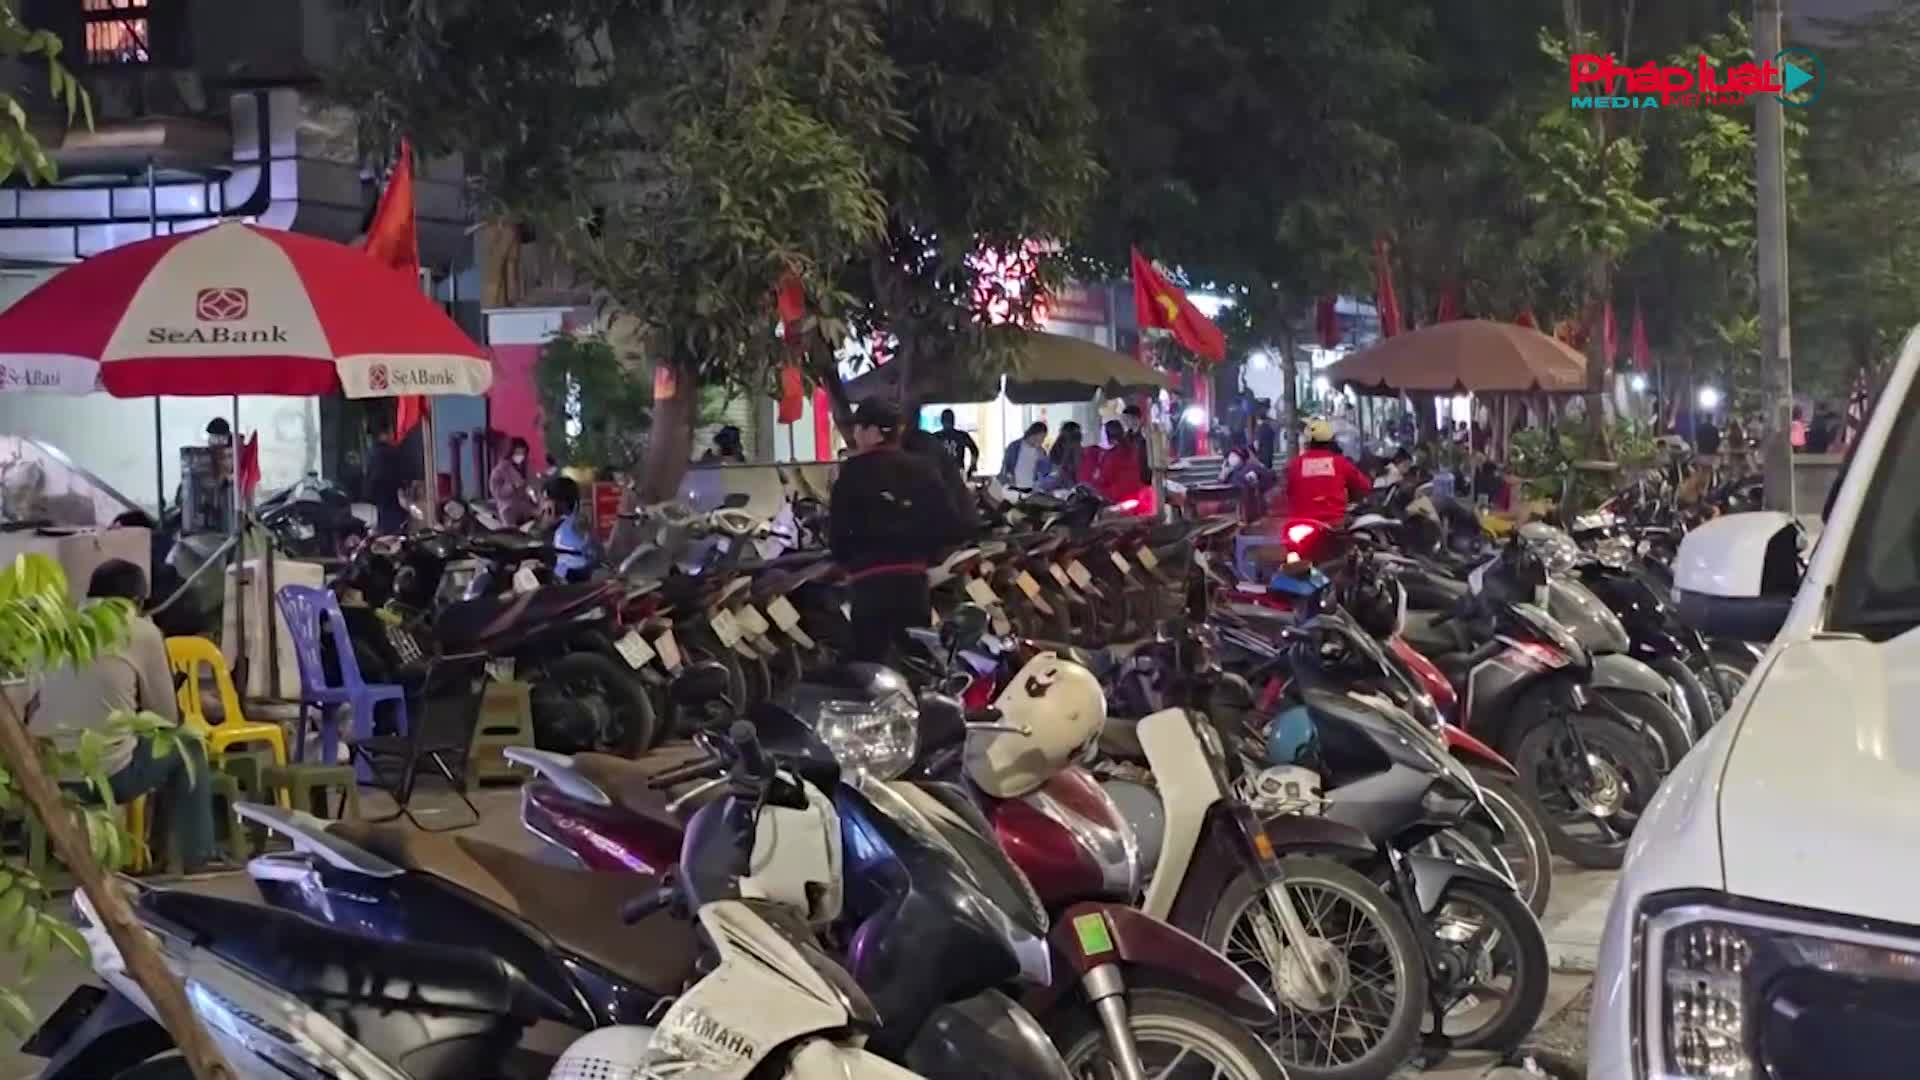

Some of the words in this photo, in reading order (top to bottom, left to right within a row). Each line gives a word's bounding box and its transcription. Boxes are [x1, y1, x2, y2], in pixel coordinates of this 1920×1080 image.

[146, 325, 287, 344] SeABank
[392, 367, 456, 385] SeABank
[679, 1007, 754, 1060] YAMAHA
